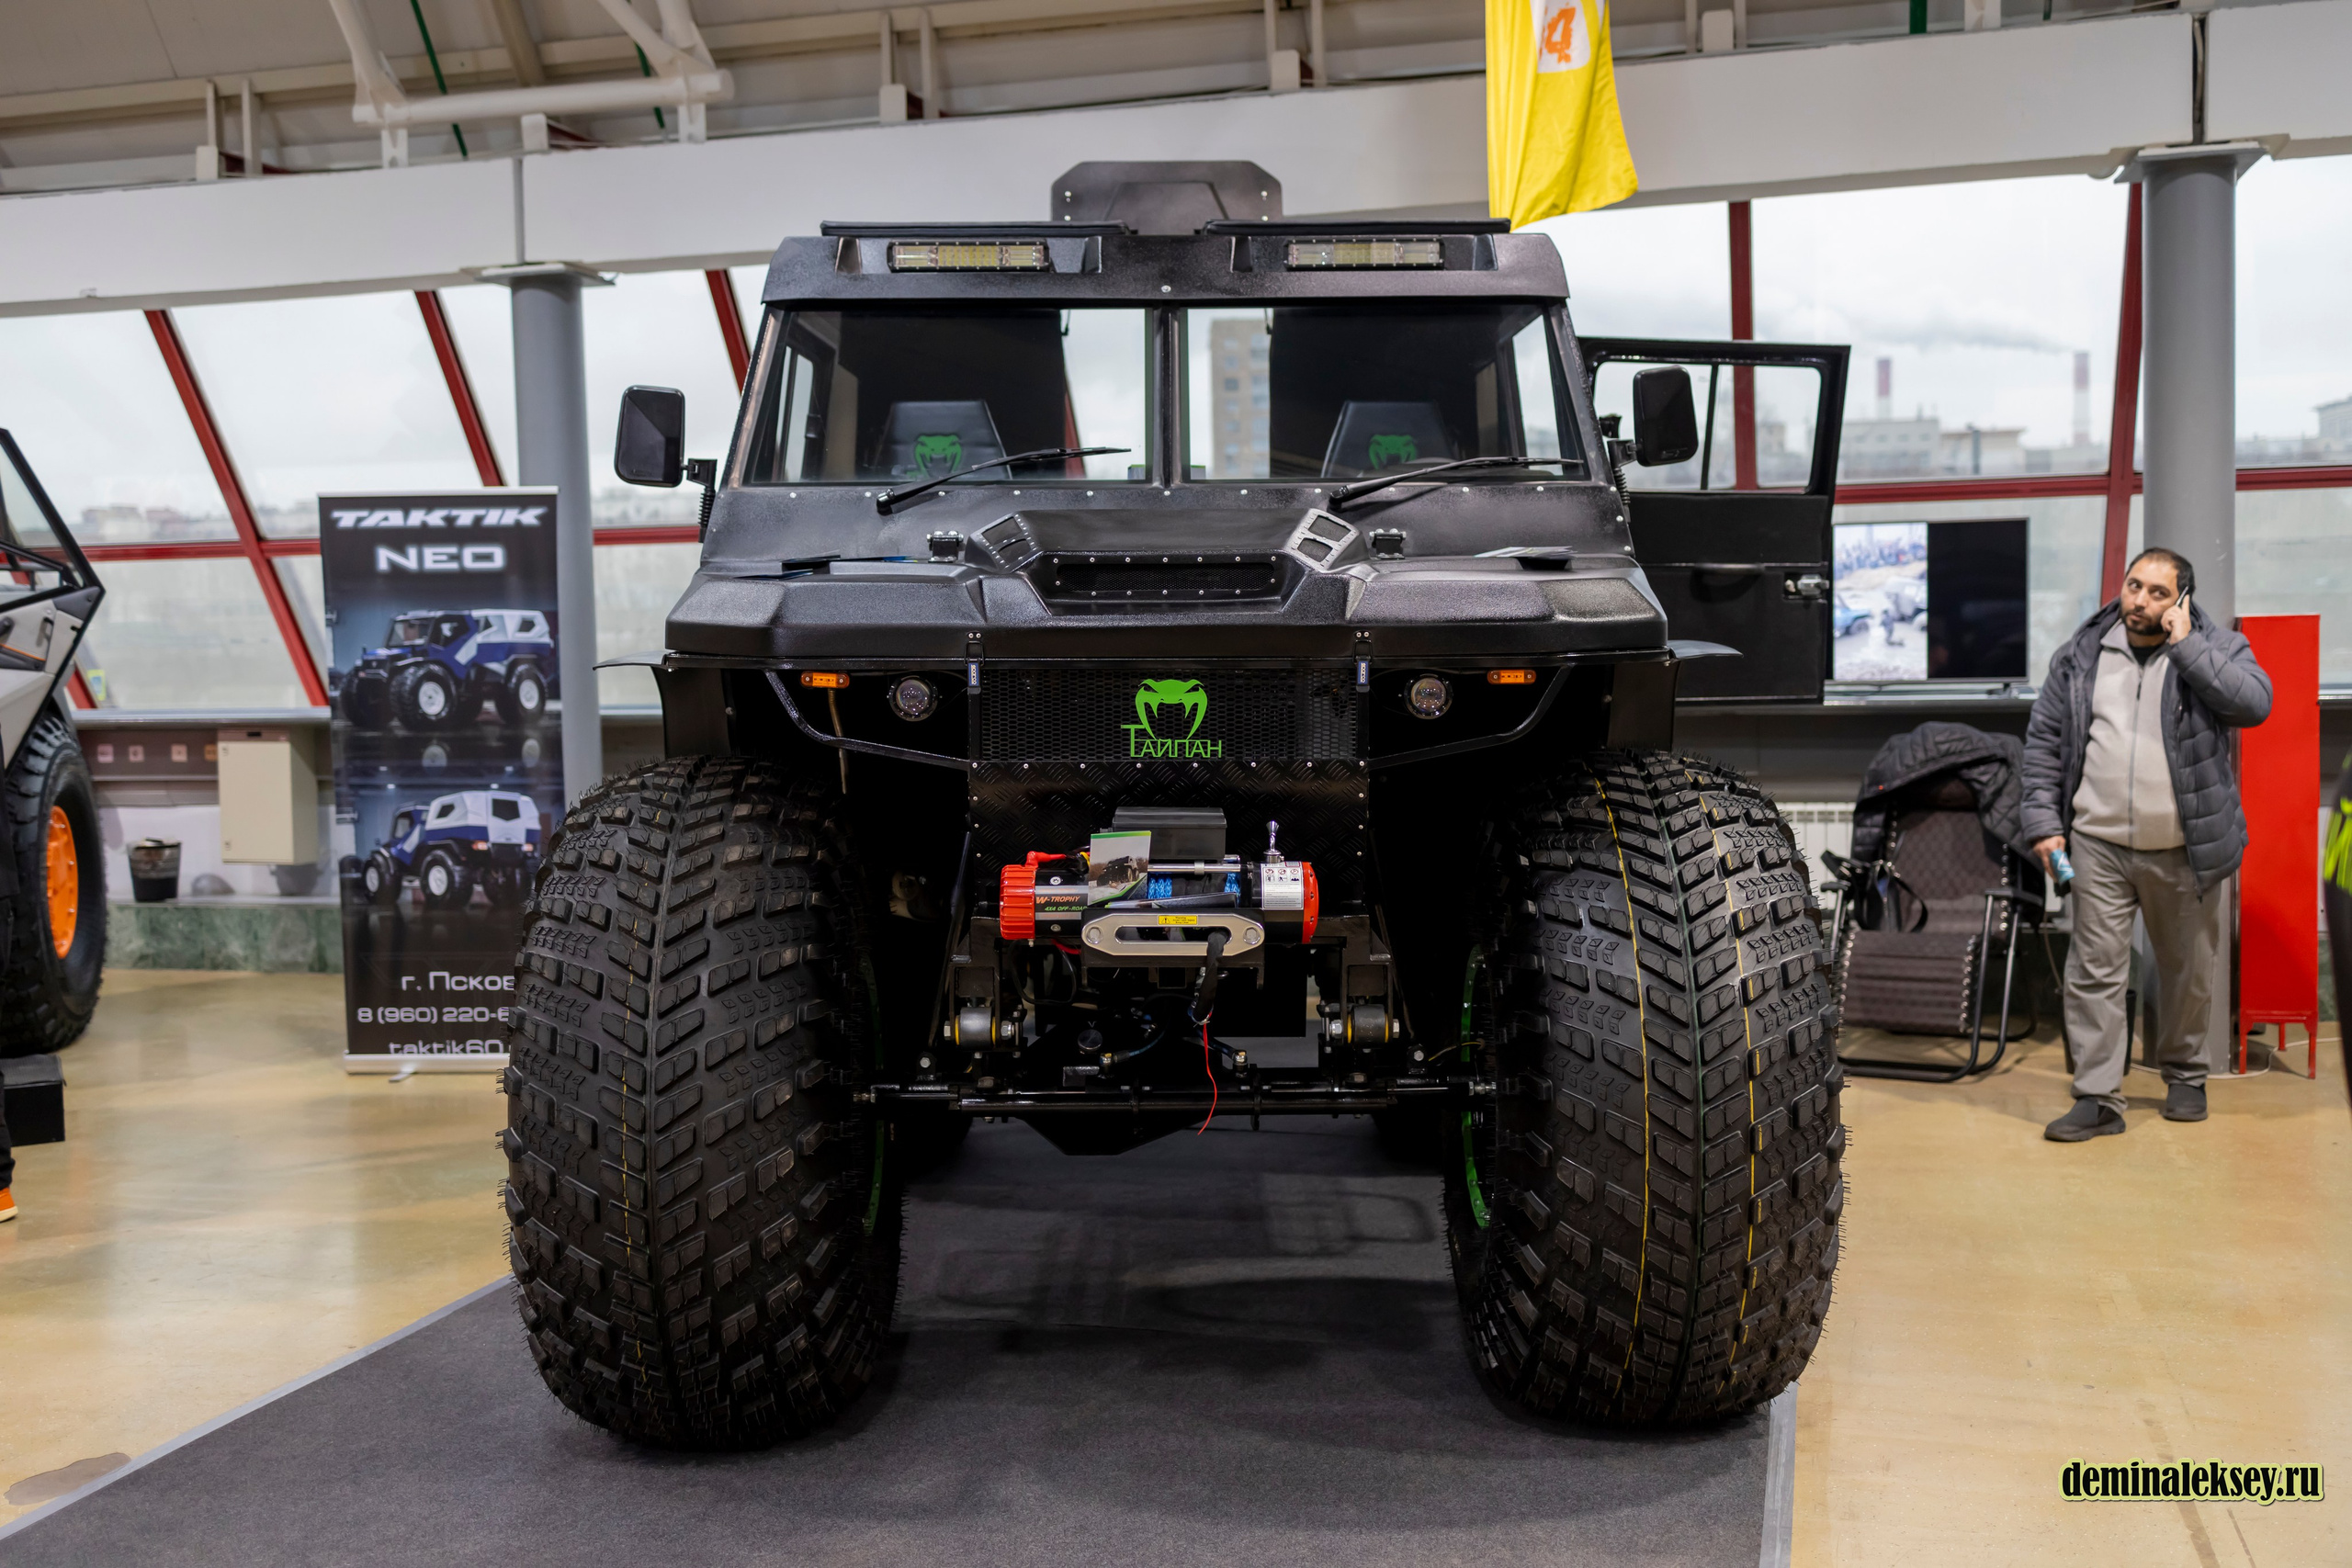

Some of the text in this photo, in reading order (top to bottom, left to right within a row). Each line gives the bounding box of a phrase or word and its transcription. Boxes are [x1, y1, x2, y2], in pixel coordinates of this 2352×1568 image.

[332, 507, 547, 528] TAKTIK
[377, 546, 506, 571] NEO
[401, 976, 423, 991] г.
[357, 1007, 373, 1023] 8
[378, 1007, 437, 1024] (960)
